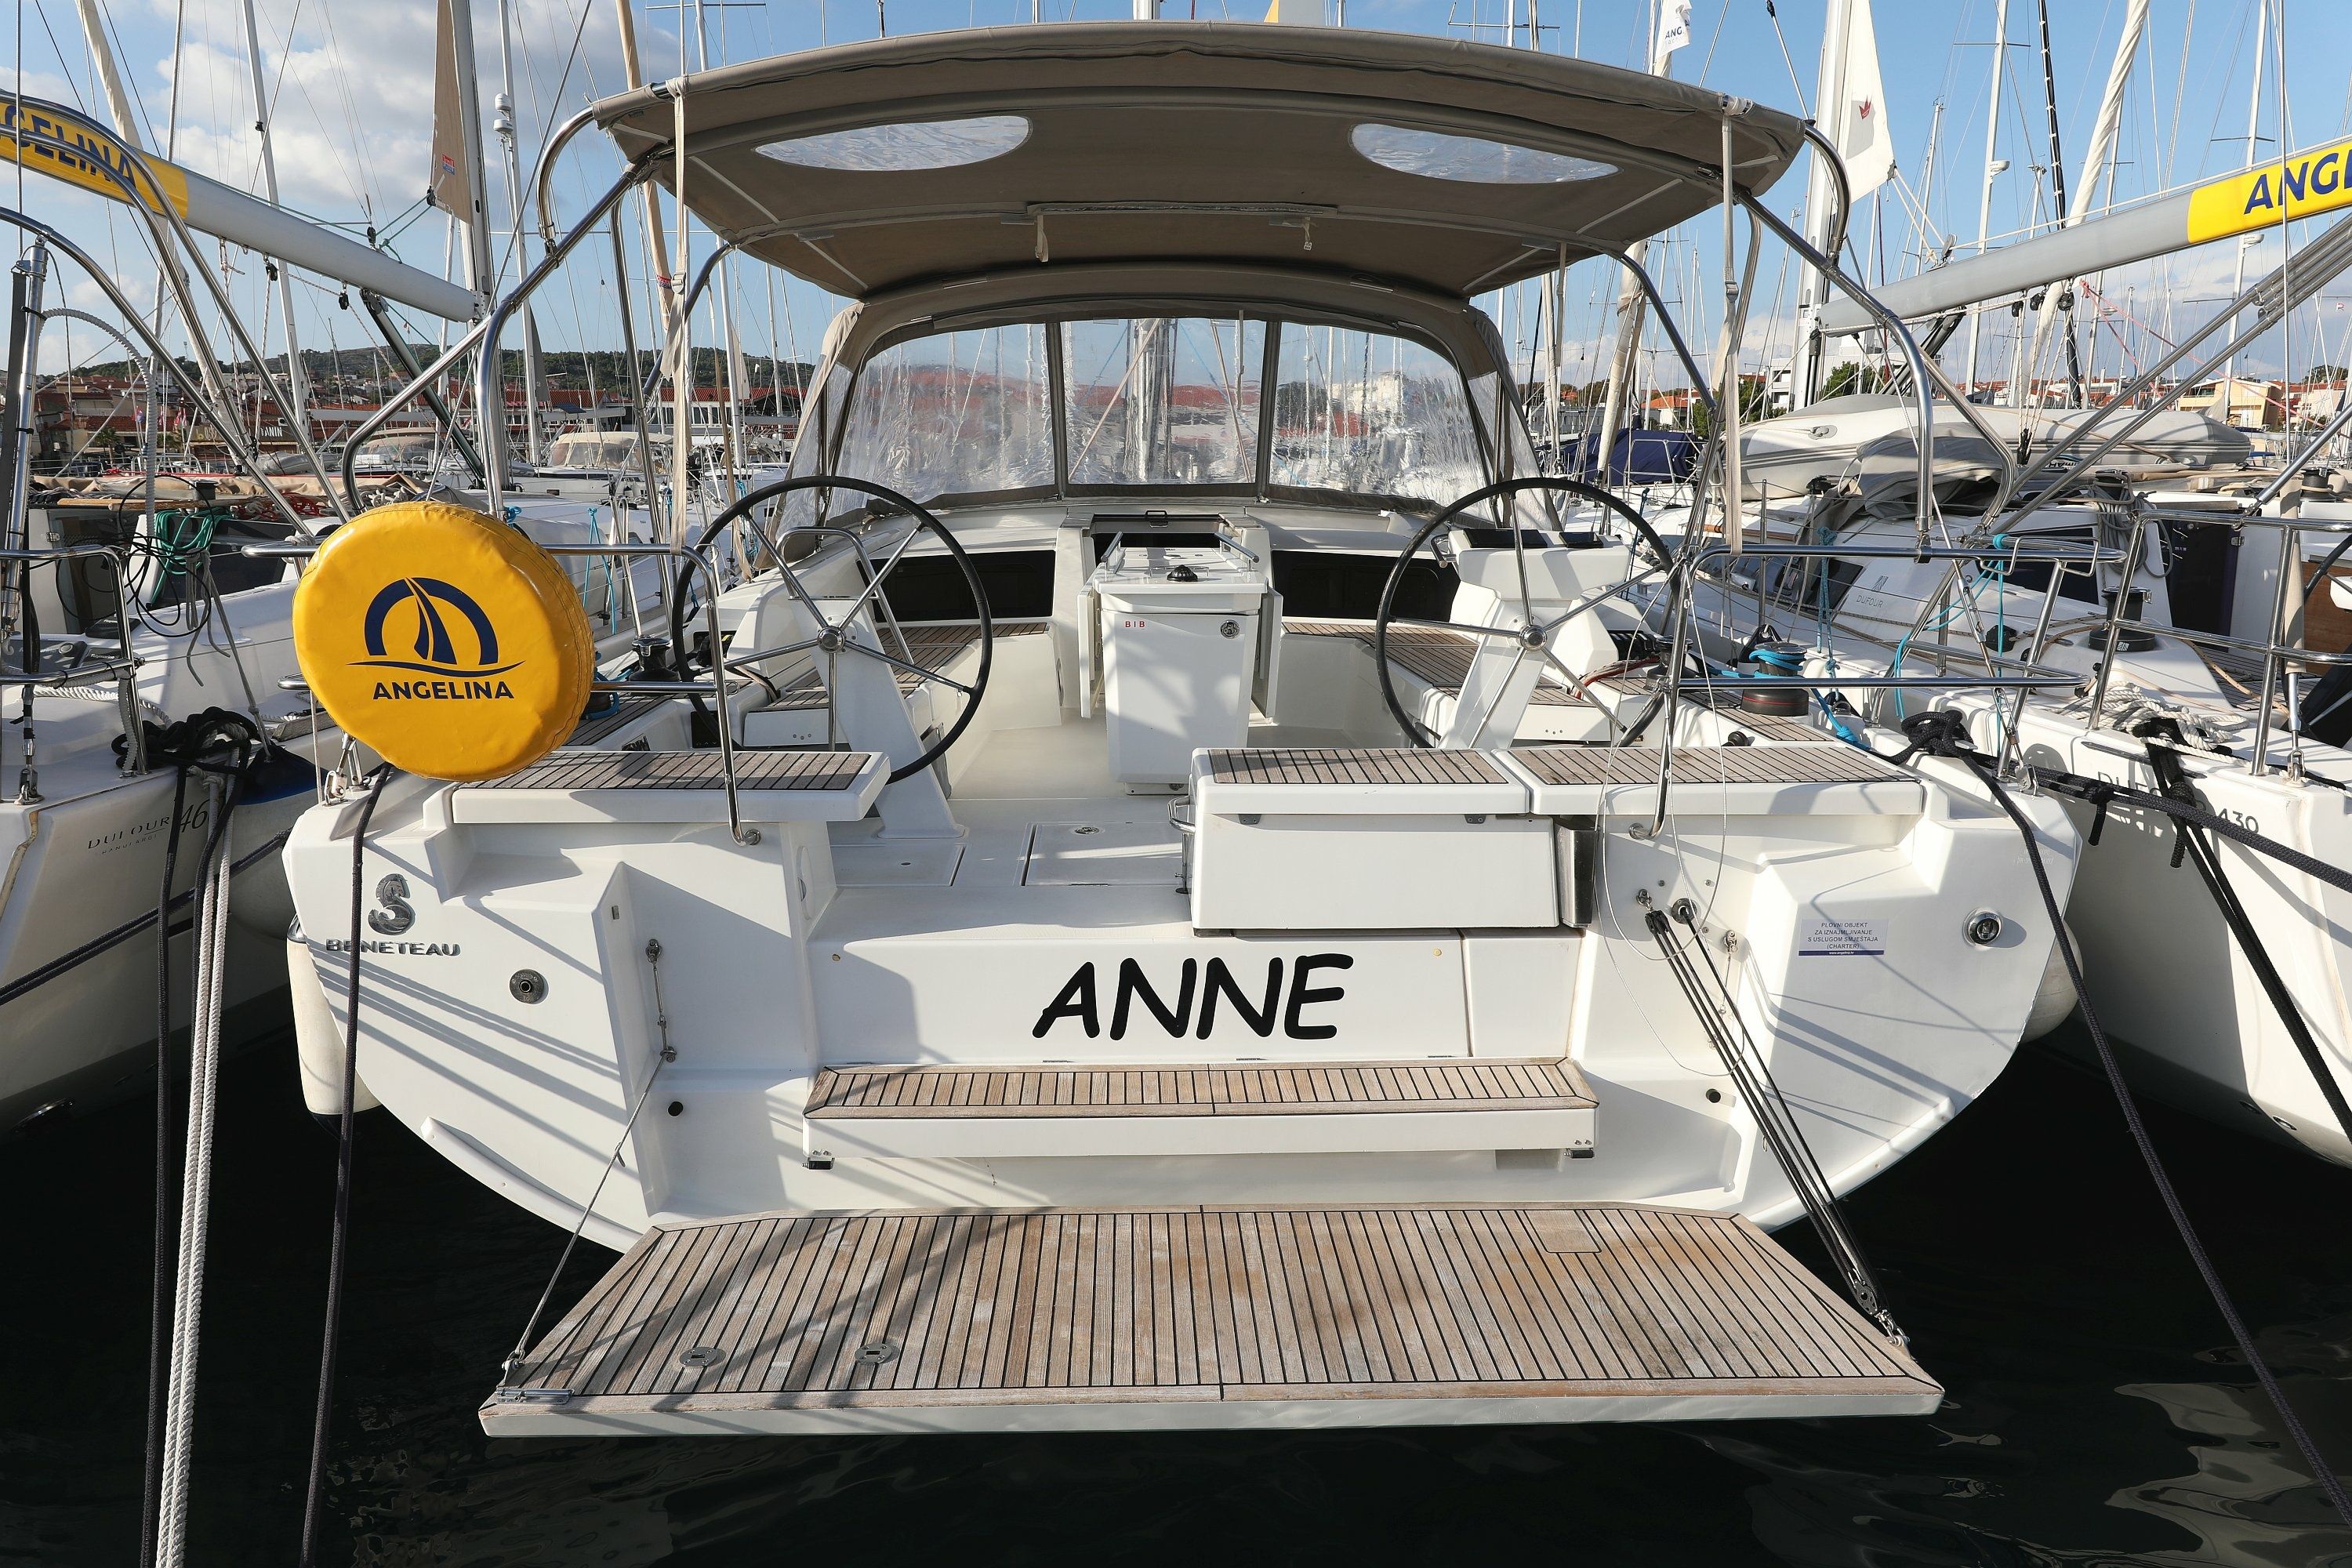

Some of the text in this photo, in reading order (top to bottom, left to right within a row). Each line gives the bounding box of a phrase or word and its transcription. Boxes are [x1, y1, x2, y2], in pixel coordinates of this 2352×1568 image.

[1856, 594, 1884, 608] DUFOUR
[372, 681, 514, 700] ANGELINA
[325, 938, 461, 956] BENETEAU
[1032, 953, 1354, 1041] ANNE
